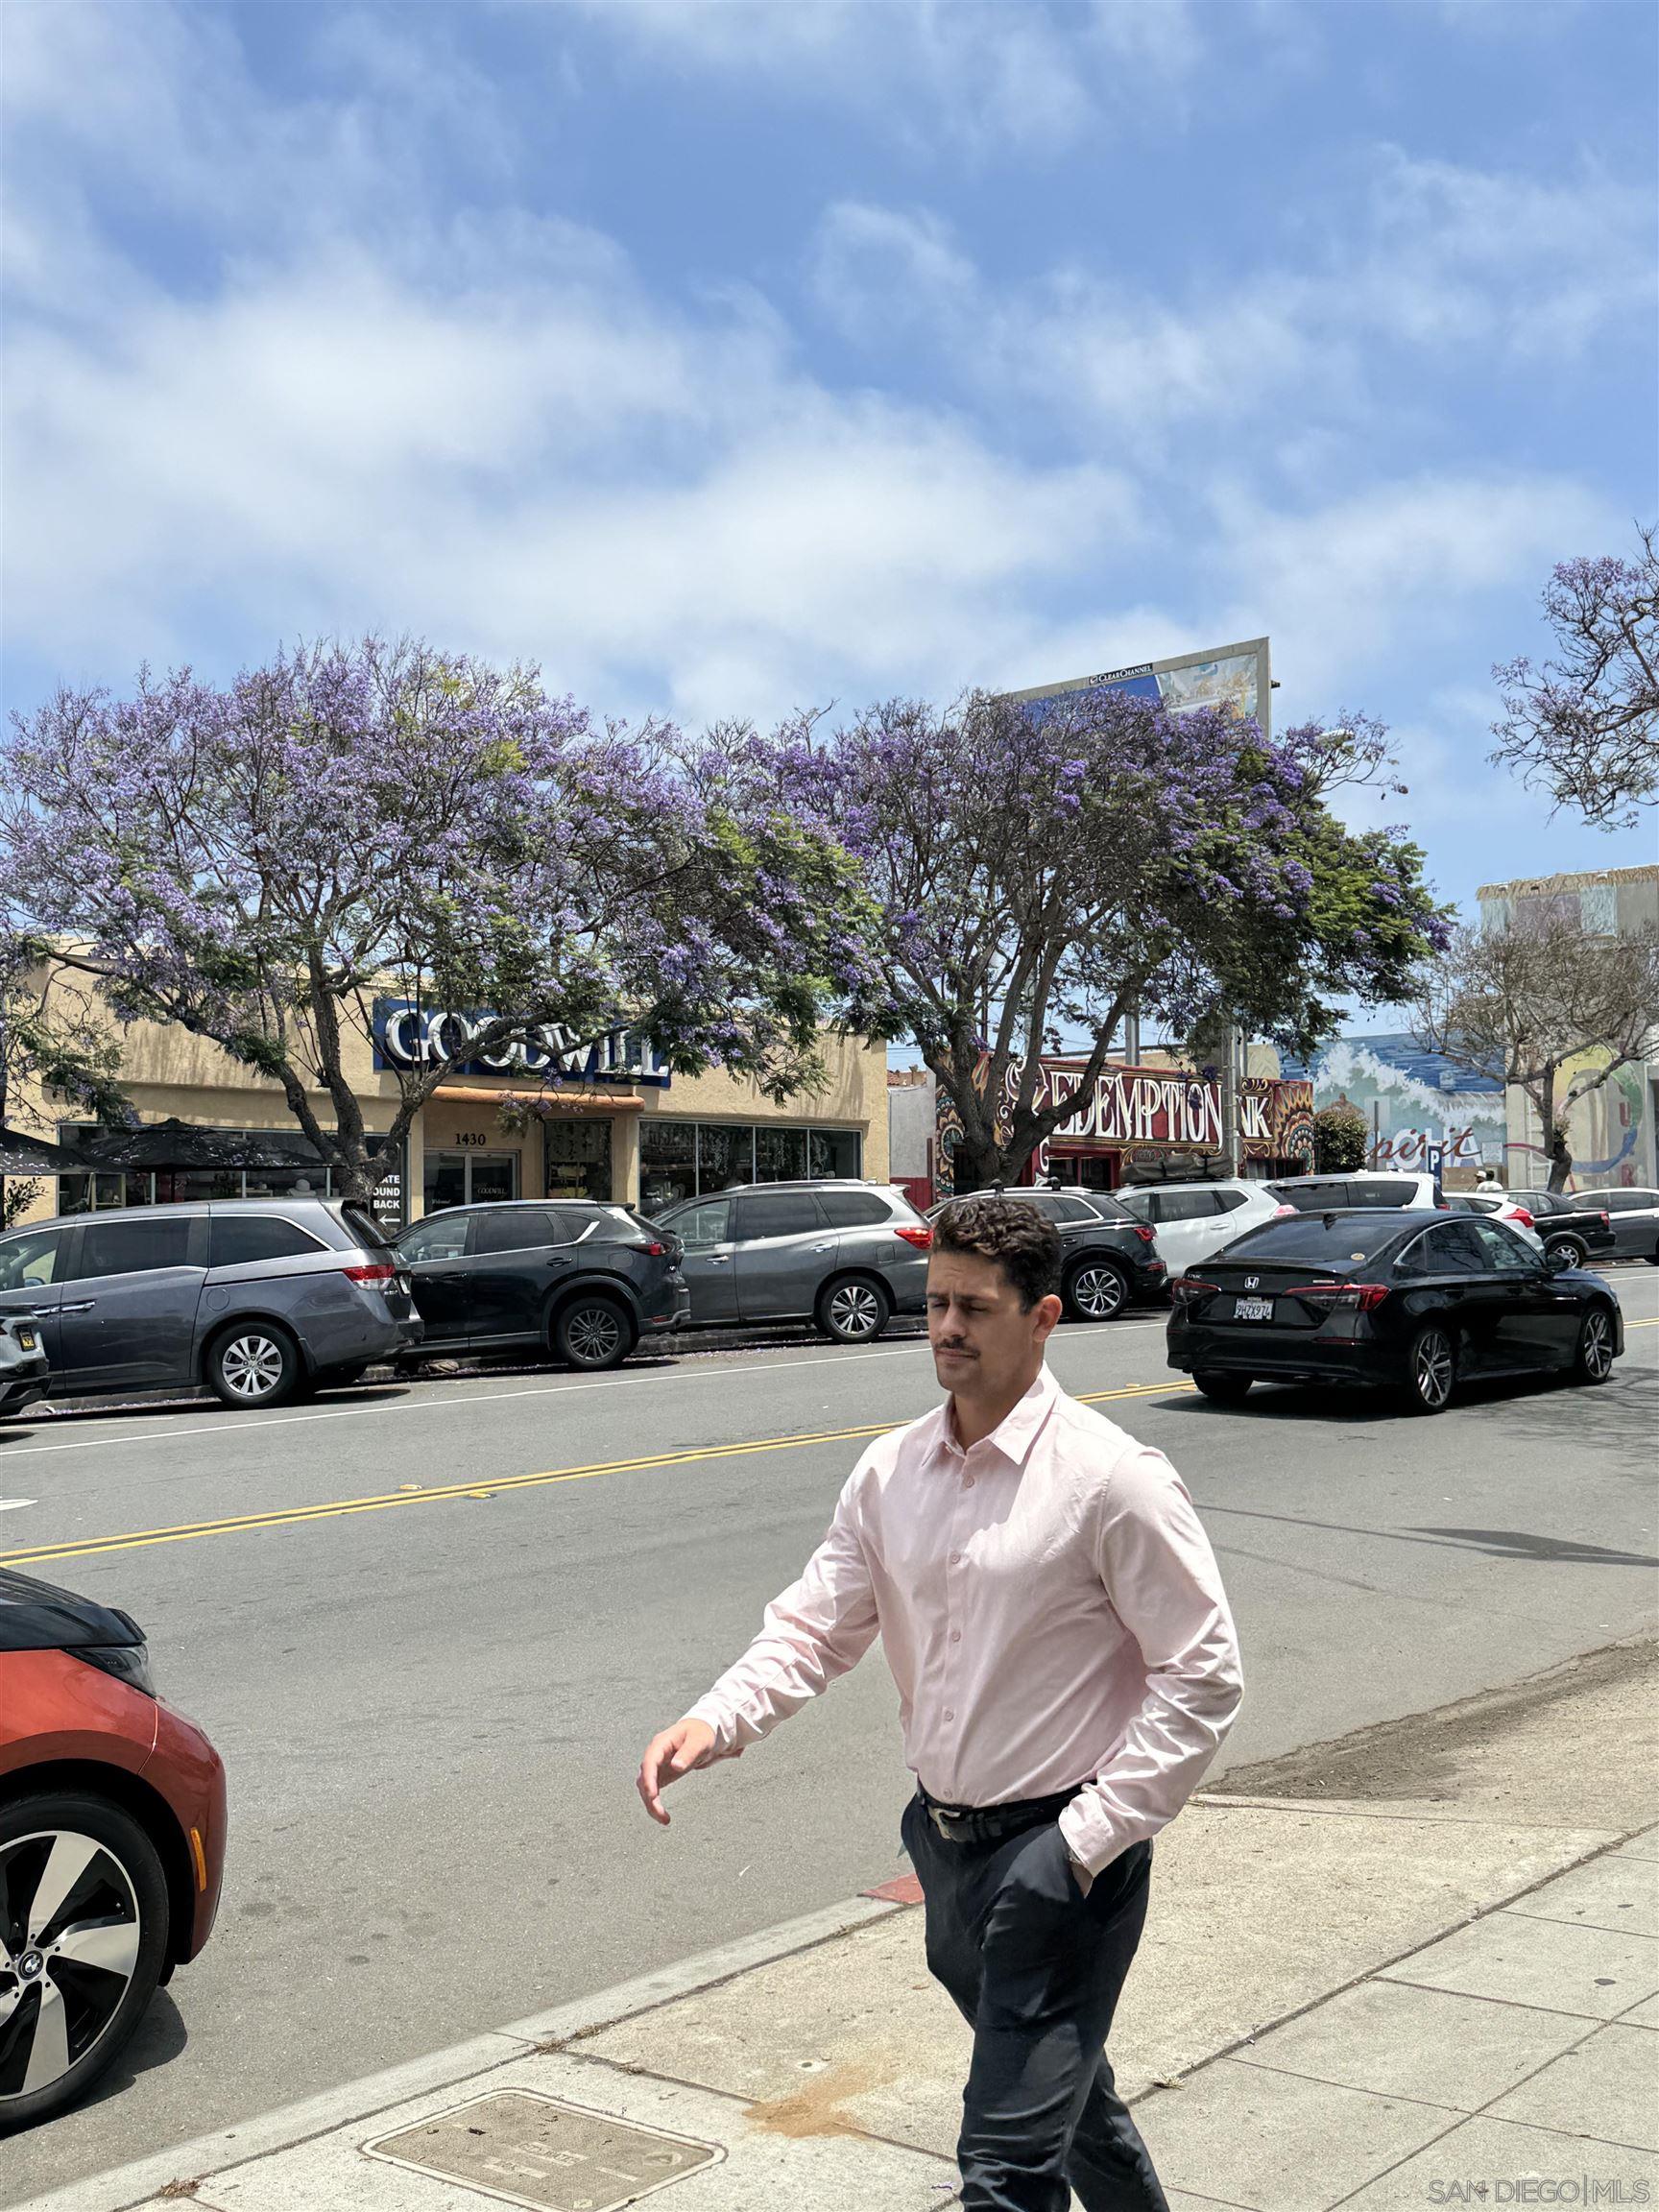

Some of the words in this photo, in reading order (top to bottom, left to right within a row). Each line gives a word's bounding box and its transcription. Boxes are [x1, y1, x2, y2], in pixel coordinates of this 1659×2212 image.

[385, 1008, 669, 1077] GOODWILL
[1235, 1096, 1273, 1139] NK
[455, 1133, 486, 1145] 1430
[1430, 1150, 1439, 1170] P
[373, 1199, 400, 1209] BACK
